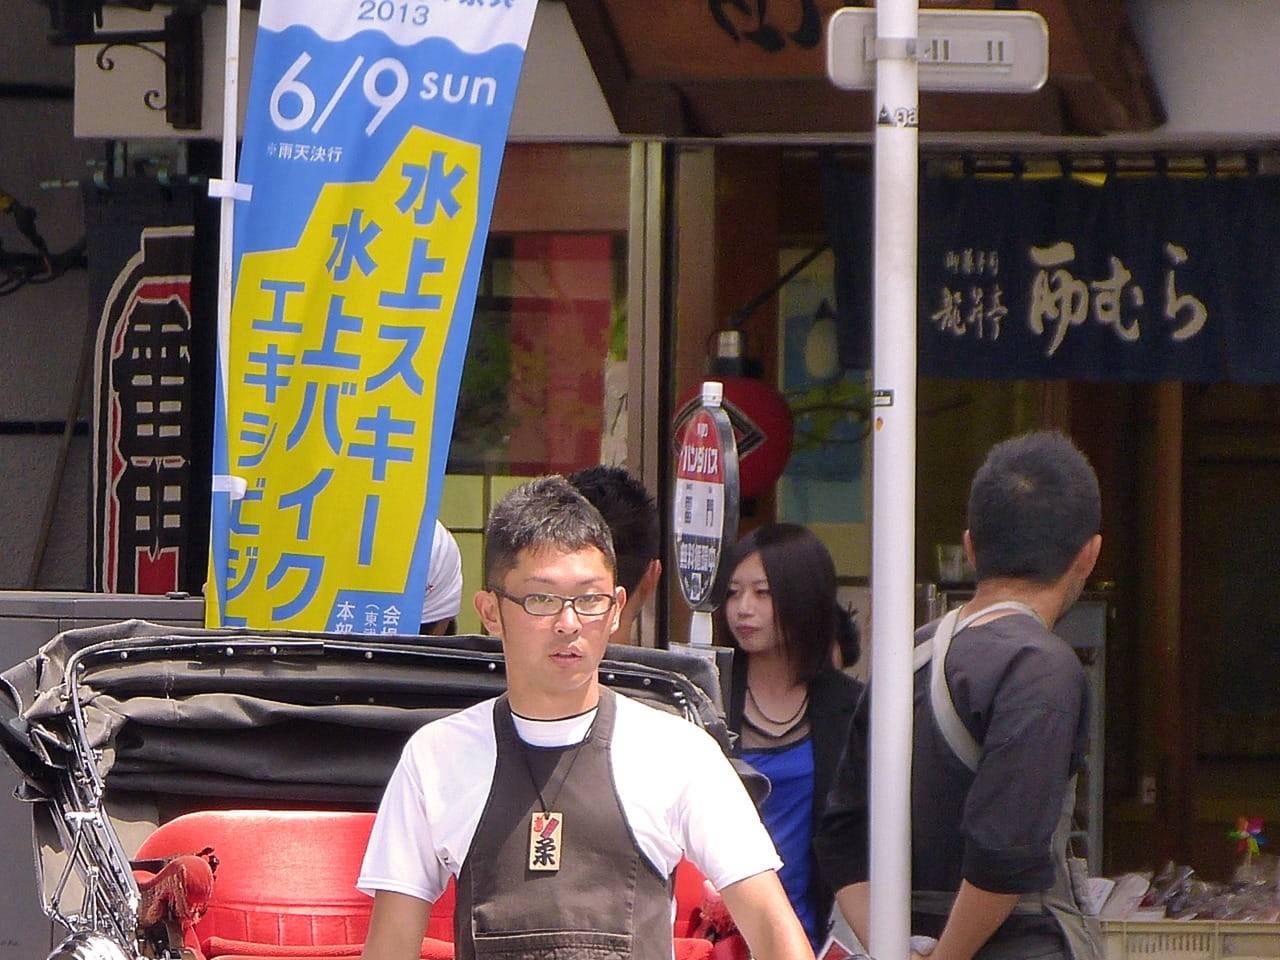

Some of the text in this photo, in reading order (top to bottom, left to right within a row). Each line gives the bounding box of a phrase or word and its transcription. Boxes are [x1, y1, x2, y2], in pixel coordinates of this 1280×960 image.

[270, 51, 497, 137] 6/9 sun
[357, 0, 430, 26] 2013
[266, 208, 383, 622] 水上バイク
[347, 151, 468, 566] 水上スキー
